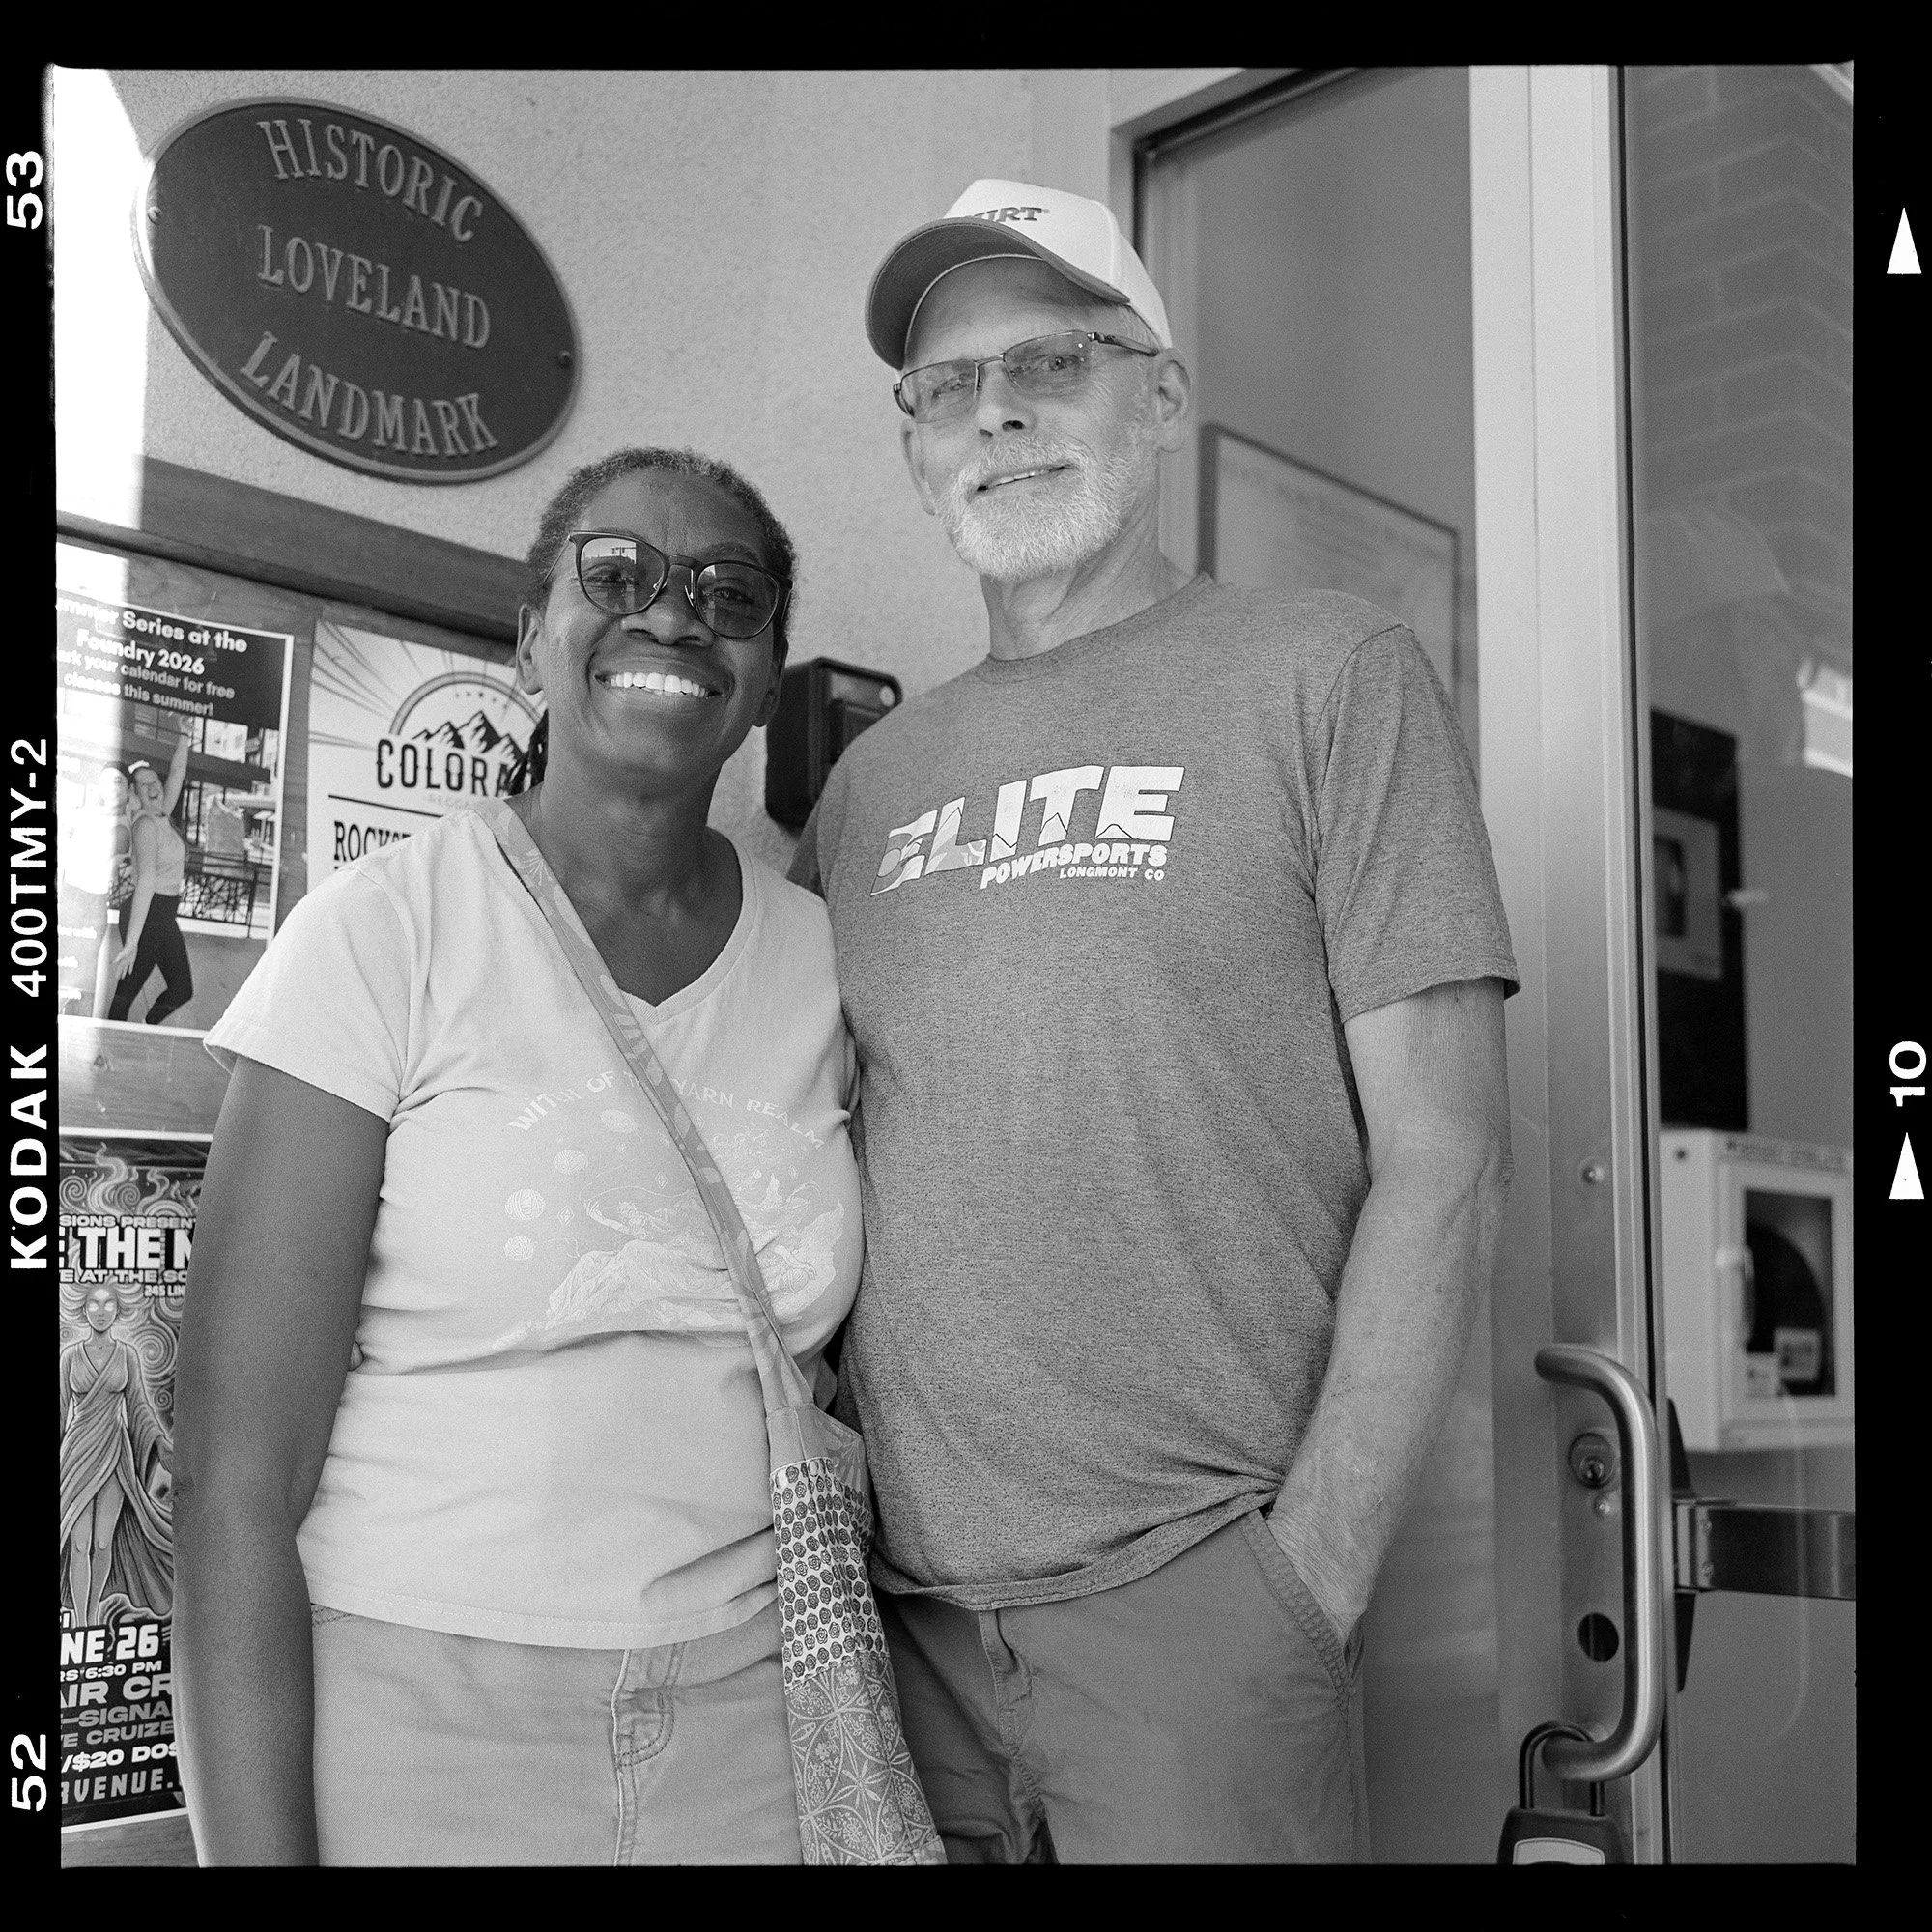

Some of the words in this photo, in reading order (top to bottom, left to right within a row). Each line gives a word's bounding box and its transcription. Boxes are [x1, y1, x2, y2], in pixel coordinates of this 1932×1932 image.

[6, 151, 44, 230] 53
[257, 118, 482, 242] HISTORIC
[257, 224, 491, 349] LOVELAND
[240, 330, 498, 458] LANDMARK
[77, 628, 155, 668] Foundry
[157, 649, 205, 676] 2026
[122, 611, 185, 641] Series
[188, 630, 210, 646] at
[214, 631, 248, 653] the
[120, 664, 181, 689] calendar
[184, 677, 204, 695] for
[206, 680, 236, 700] free
[124, 683, 150, 702] this
[153, 692, 213, 717] summer!
[870, 765, 1185, 896] ELITE
[10, 738, 47, 996] 400TMY-2
[980, 842, 1168, 890] POWERSPORTS
[1059, 867, 1138, 880] LONGMONT
[1144, 867, 1165, 881] CO
[1889, 1041, 1926, 1107] 10
[586, 1070, 616, 1093] OF
[672, 1079, 734, 1109] YARN
[746, 1099, 826, 1150] REALM
[9, 1043, 47, 1268] KODAK
[121, 1216, 196, 1229] PRESEN
[77, 1226, 162, 1269] THE
[80, 1269, 108, 1283] AT
[114, 1269, 158, 1284] THE
[116, 1623, 159, 1660] 26
[85, 1663, 127, 1680] 6:30
[131, 1660, 162, 1674] PM
[11, 1734, 46, 1812] 52
